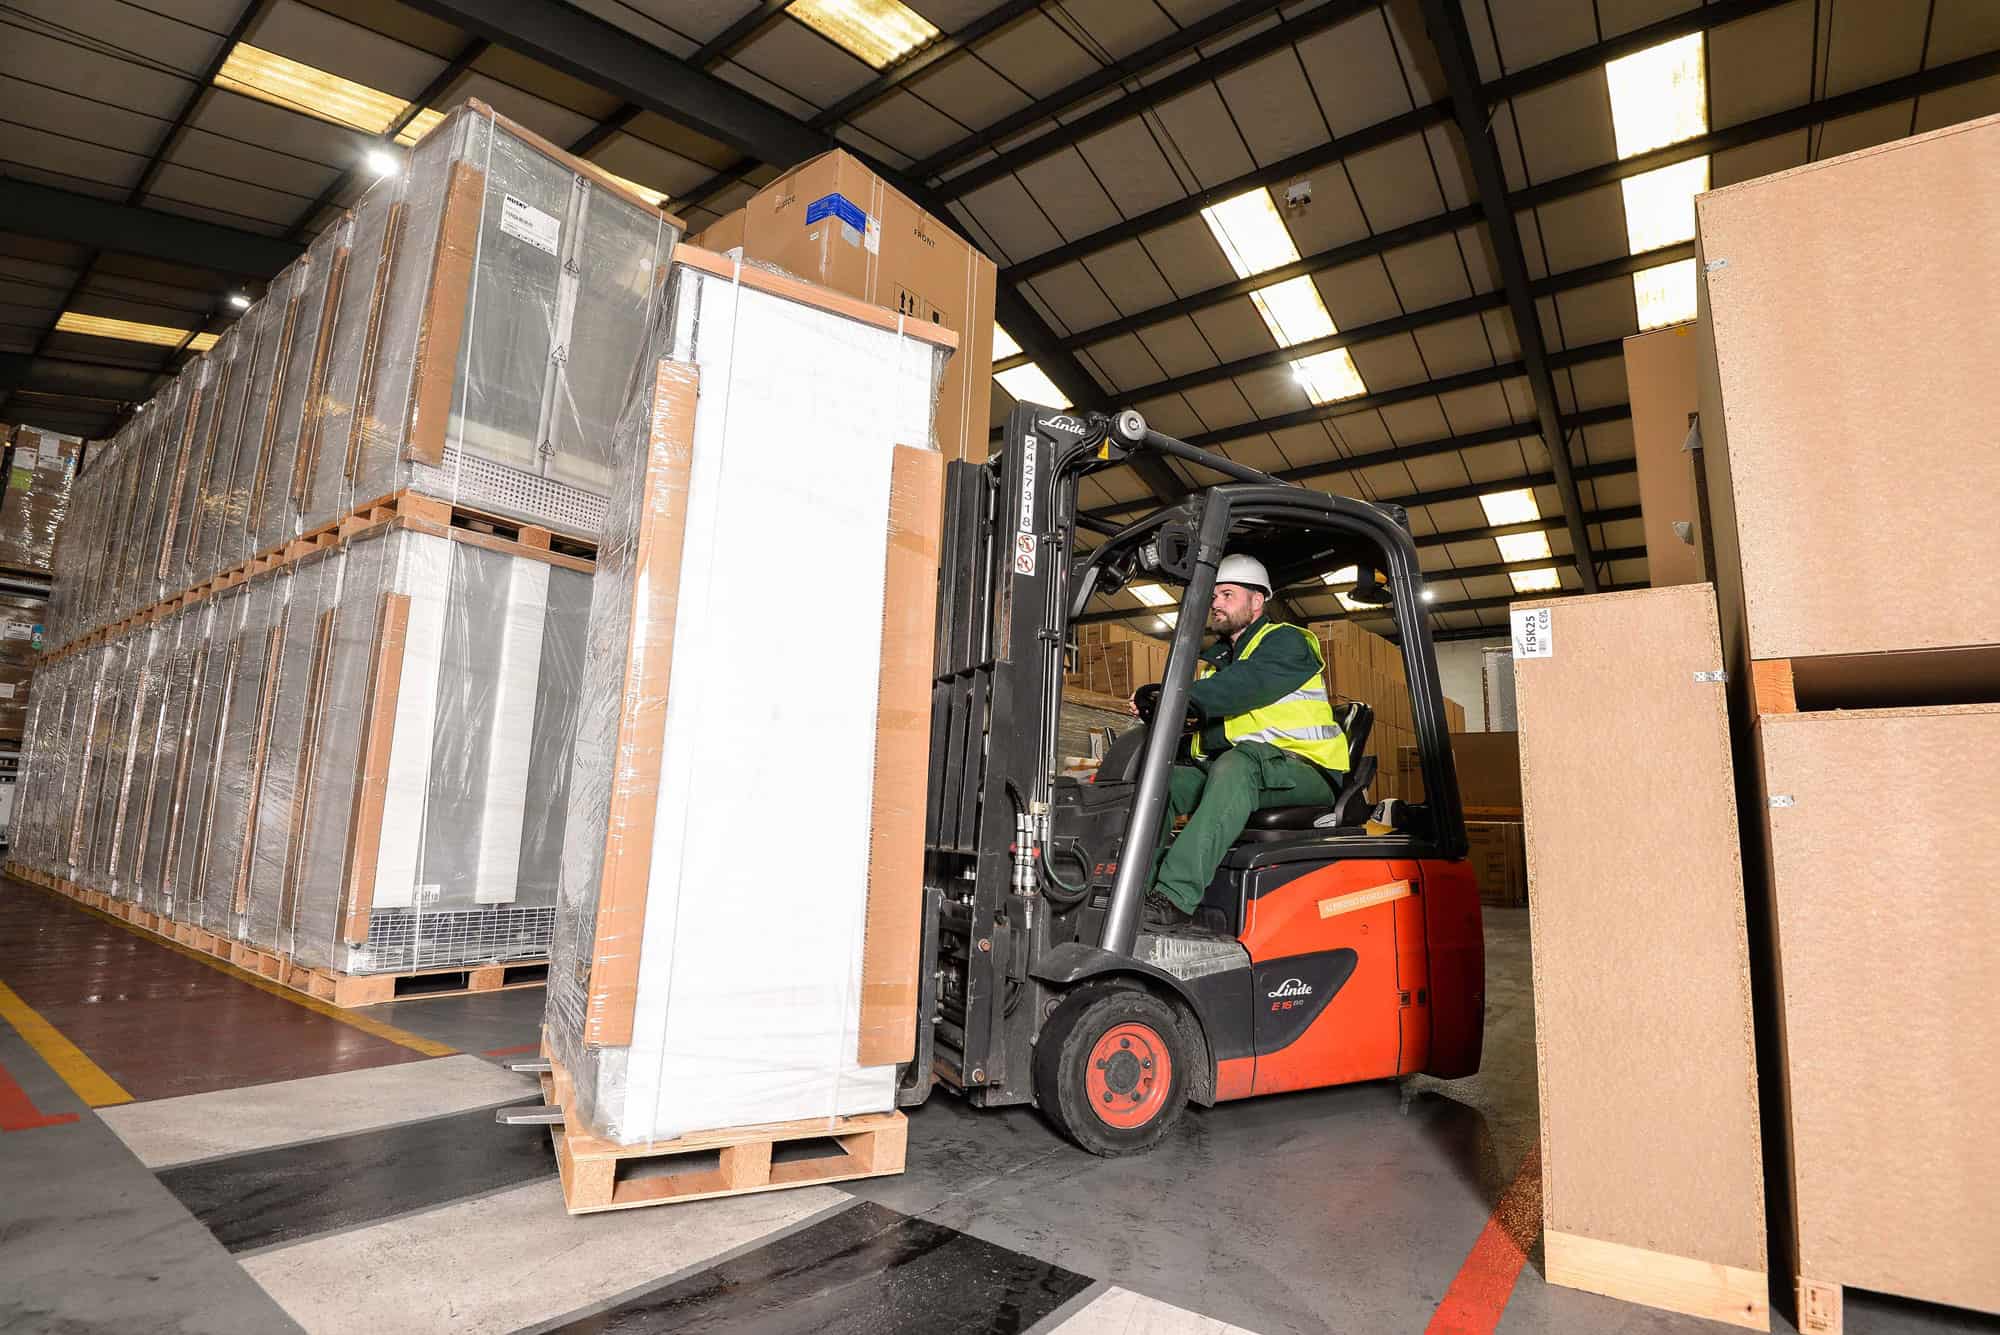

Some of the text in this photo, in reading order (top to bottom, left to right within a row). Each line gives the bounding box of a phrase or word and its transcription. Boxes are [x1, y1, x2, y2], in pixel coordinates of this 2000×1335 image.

[914, 228, 935, 248] FRONT
[1038, 415, 1086, 435] Linde
[1022, 440, 1035, 527] 2427318
[1526, 615, 1537, 652] FISK25
[1267, 978, 1313, 998] Linde
